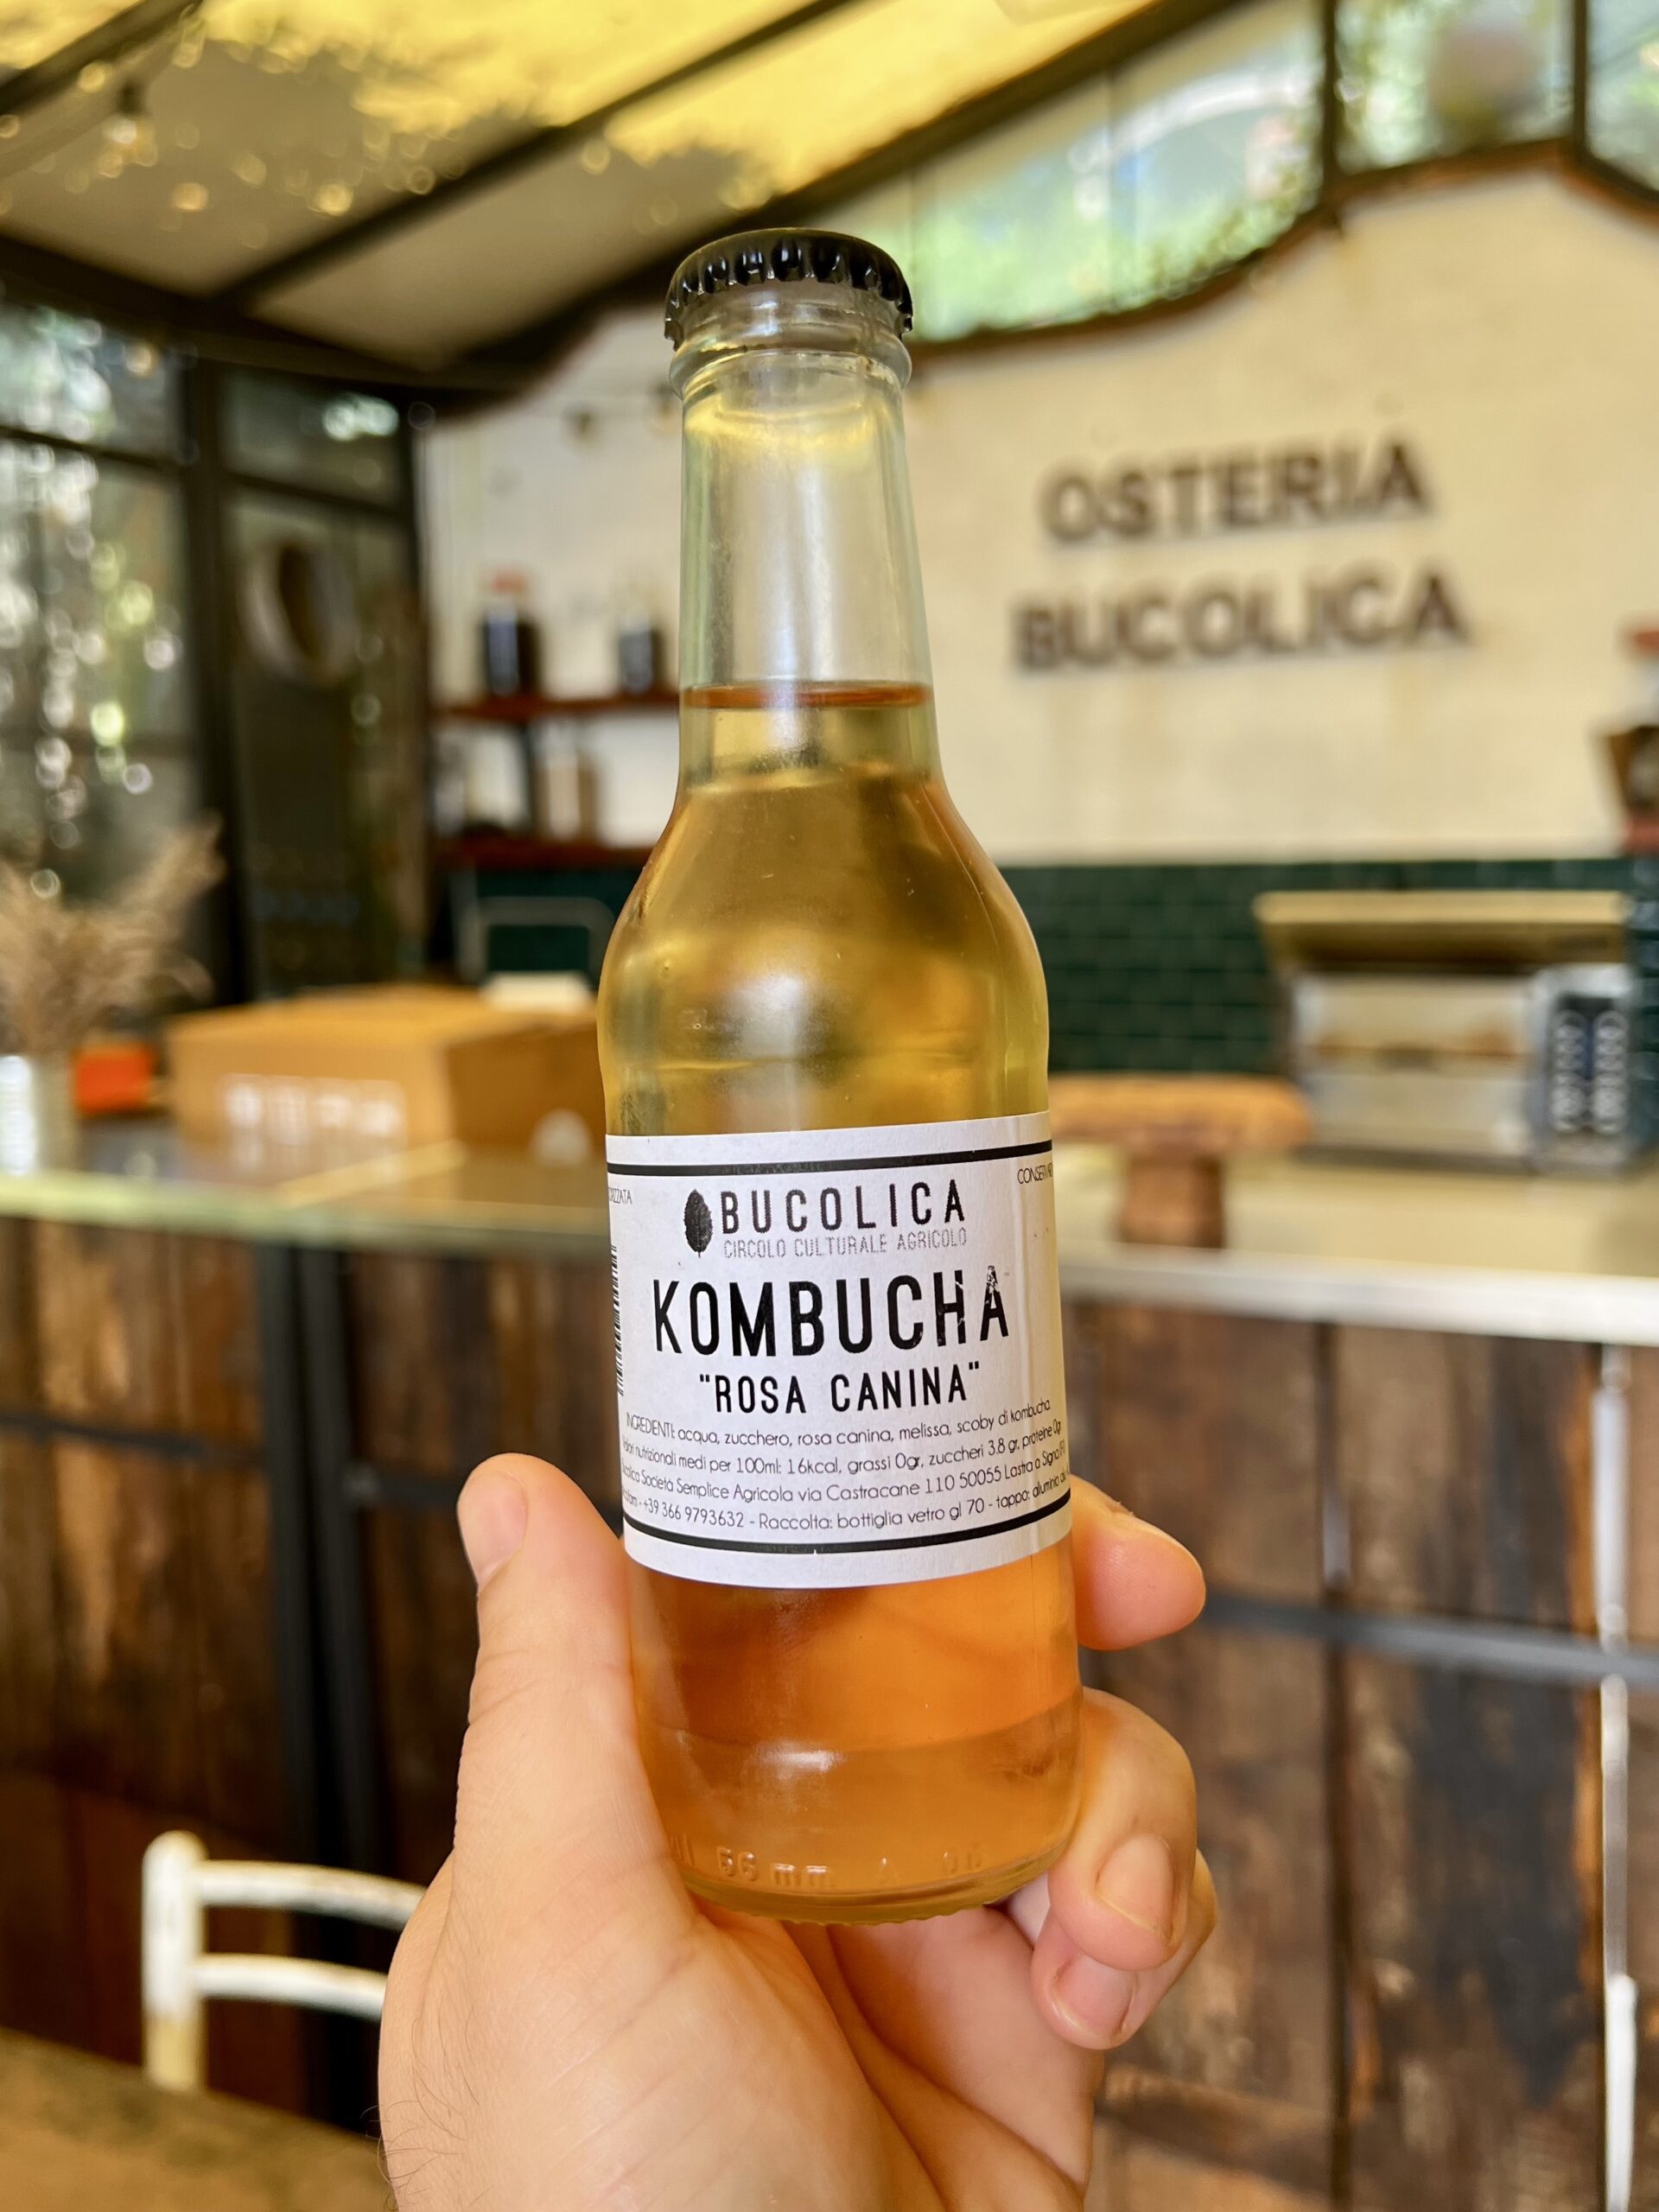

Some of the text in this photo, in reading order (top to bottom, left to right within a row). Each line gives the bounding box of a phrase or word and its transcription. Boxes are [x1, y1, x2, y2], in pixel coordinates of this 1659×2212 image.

[1039, 436, 1433, 544] OSTERIA
[1013, 569, 1474, 676] BUCOLICA
[720, 1179, 965, 1234] BUCOLICA
[723, 1226, 967, 1259] CIRCOLO CULTURALE AGRICOLO
[652, 1266, 1009, 1357] KOMBUCHA
[699, 1360, 980, 1414] "ROSA CANINA"
[677, 1428, 720, 1445] acqua,
[724, 1429, 792, 1447] zucchero,
[798, 1433, 832, 1446] rosa
[836, 1428, 894, 1445] canina,
[899, 1421, 952, 1440] melissa,
[957, 1414, 995, 1432] scoby
[998, 1408, 1008, 1426] di
[1010, 1397, 1051, 1423] kombucha
[677, 1477, 730, 1500] Semplice
[733, 1483, 793, 1503] Agricola
[798, 1488, 822, 1502] via
[826, 1483, 920, 1502] Castracane
[925, 1474, 956, 1495] 110
[959, 1465, 1002, 1490] 50055
[1004, 1461, 1033, 1480] Lastra
[1034, 1458, 1040, 1470] a
[1042, 1449, 1059, 1466] Signa
[678, 1454, 707, 1471] medi
[709, 1459, 731, 1473] per
[736, 1457, 782, 1475] 100ml:
[787, 1457, 842, 1476] 16kcal,
[848, 1455, 891, 1475] grassi
[929, 1444, 983, 1466] zuccheri
[988, 1437, 1006, 1456] 3.8
[1022, 1426, 1052, 1450] proteine
[644, 1497, 659, 1514] +39
[662, 1501, 682, 1521] 366
[684, 1506, 745, 1529] 9793632
[759, 1512, 833, 1530] Raccolta:
[836, 1510, 903, 1529] bottiglia
[906, 1506, 946, 1523] vetro
[949, 1501, 962, 1522] gl
[966, 1497, 985, 1516] 70
[995, 1489, 1031, 1510] tappo:
